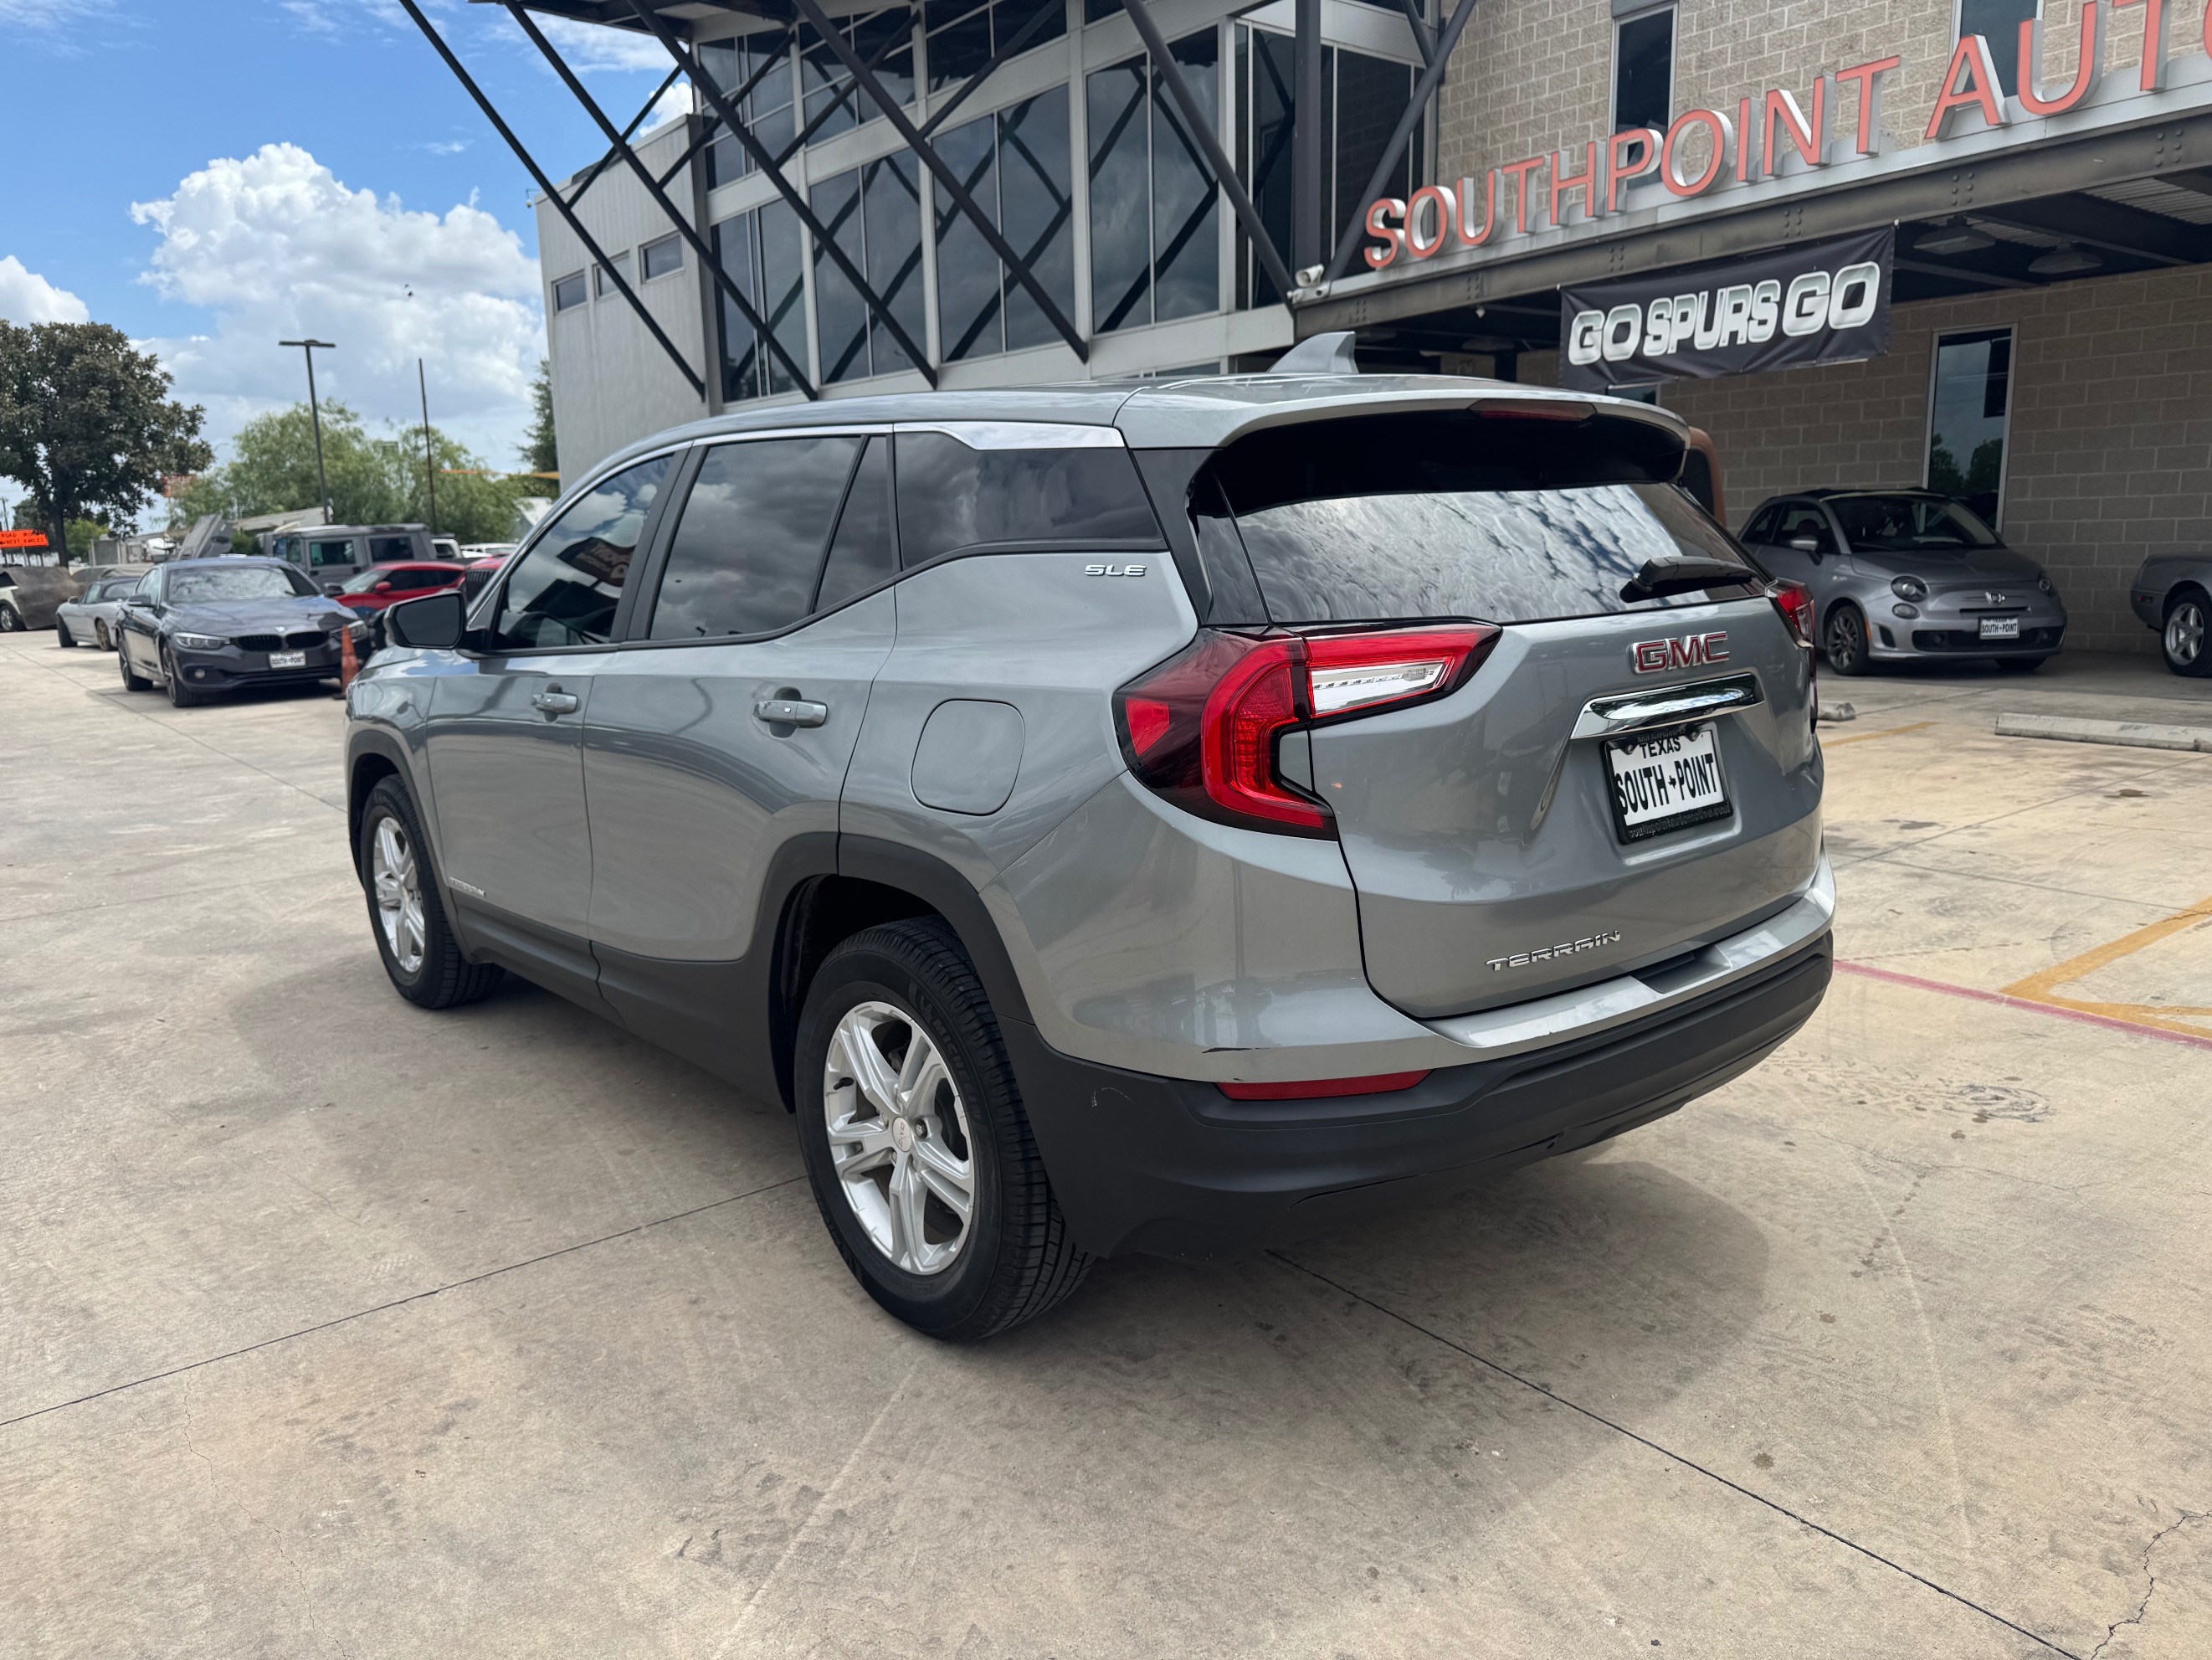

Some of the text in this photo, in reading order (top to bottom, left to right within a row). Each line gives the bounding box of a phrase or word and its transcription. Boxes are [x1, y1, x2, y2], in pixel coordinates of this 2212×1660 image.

[1364, 0, 2212, 269] SOUTHPOINT AUT
[1568, 261, 1880, 366] GO SPURS GO
[1085, 564, 1147, 577] SLE
[1631, 630, 1730, 675] GMC
[1640, 737, 1681, 758] TEXAS
[1615, 753, 1717, 815] SOUTH POINT
[1486, 930, 1620, 971] TERRAIN
